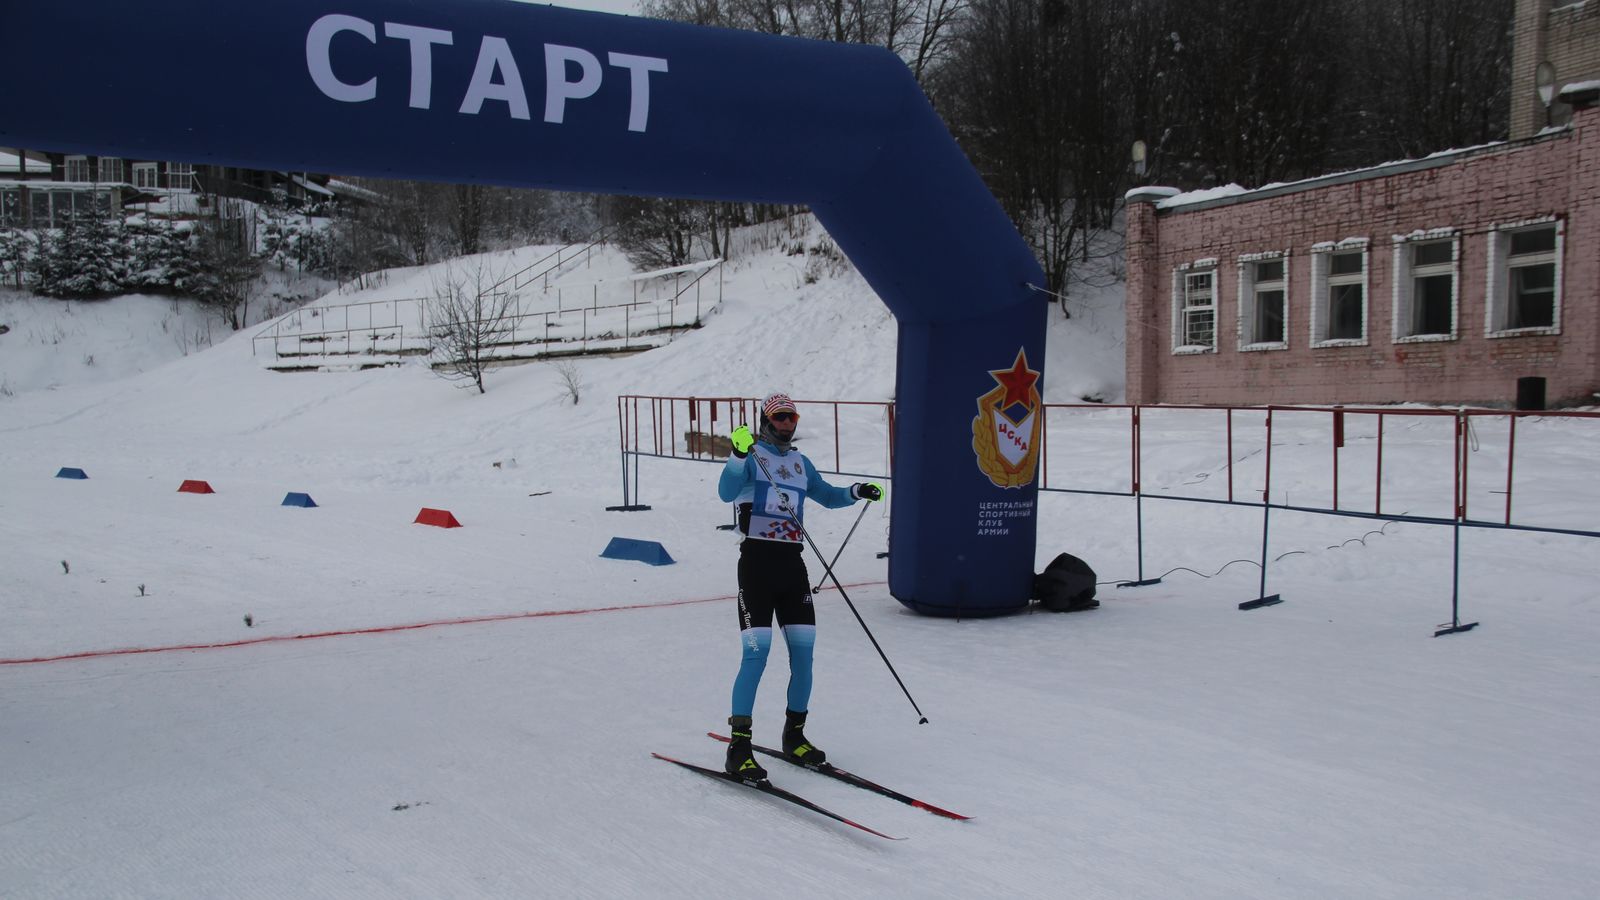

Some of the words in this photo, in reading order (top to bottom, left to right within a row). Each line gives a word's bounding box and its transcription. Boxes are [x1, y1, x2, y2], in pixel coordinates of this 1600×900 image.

[305, 13, 669, 133] СТАРТ
[999, 423, 1027, 450] ЦСКА
[979, 501, 1033, 510] ЦЕНТРАЛЬНЫЙ
[978, 509, 1031, 518] СПОРТИВНЫЙ
[977, 519, 1003, 527] КЛУБ
